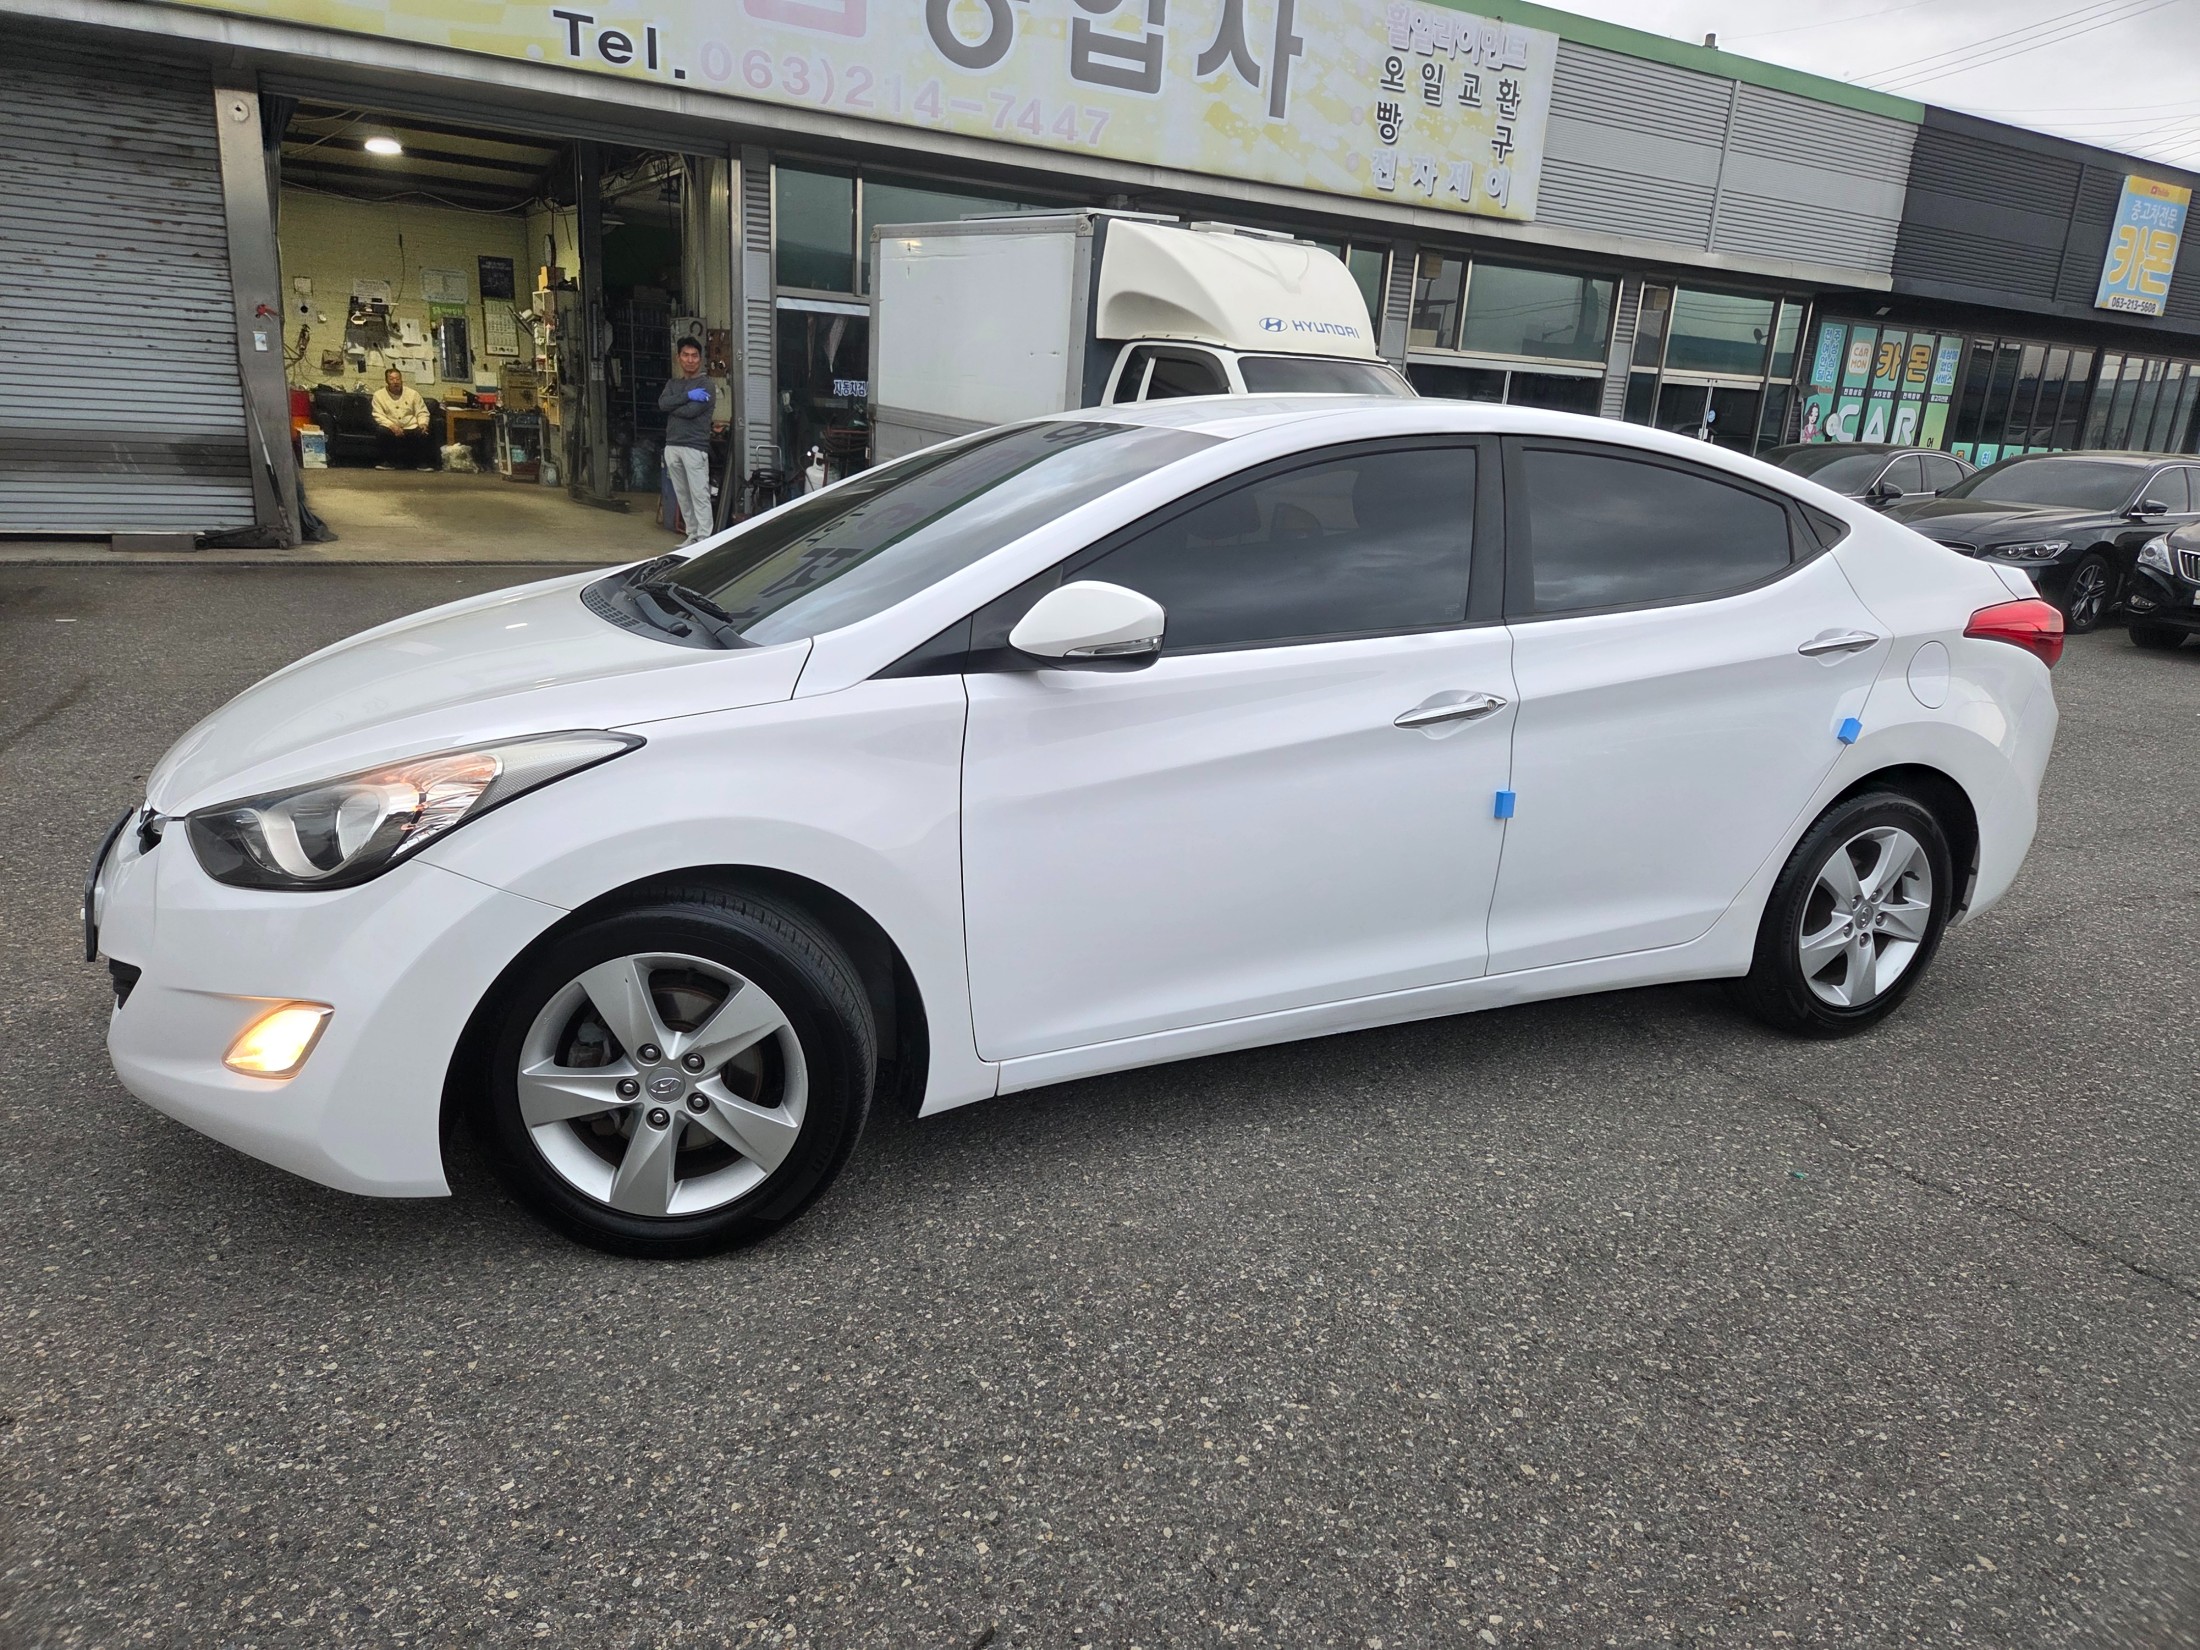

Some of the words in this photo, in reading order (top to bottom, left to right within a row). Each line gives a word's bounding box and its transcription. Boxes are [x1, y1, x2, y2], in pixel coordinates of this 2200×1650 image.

[552, 9, 687, 80] Tel.
[700, 41, 1111, 146] 063)214-7447
[1380, 56, 1519, 117] 오일교환
[2131, 200, 2178, 229] 중고차전문
[2108, 225, 2178, 295] 카몬
[1291, 320, 1360, 339] HYUNDAI
[1850, 359, 1867, 369] MON
[1854, 347, 1869, 357] CAR
[1875, 342, 1932, 383] 카몬
[833, 379, 869, 397] 자동차검
[1833, 403, 1917, 447] CAR
